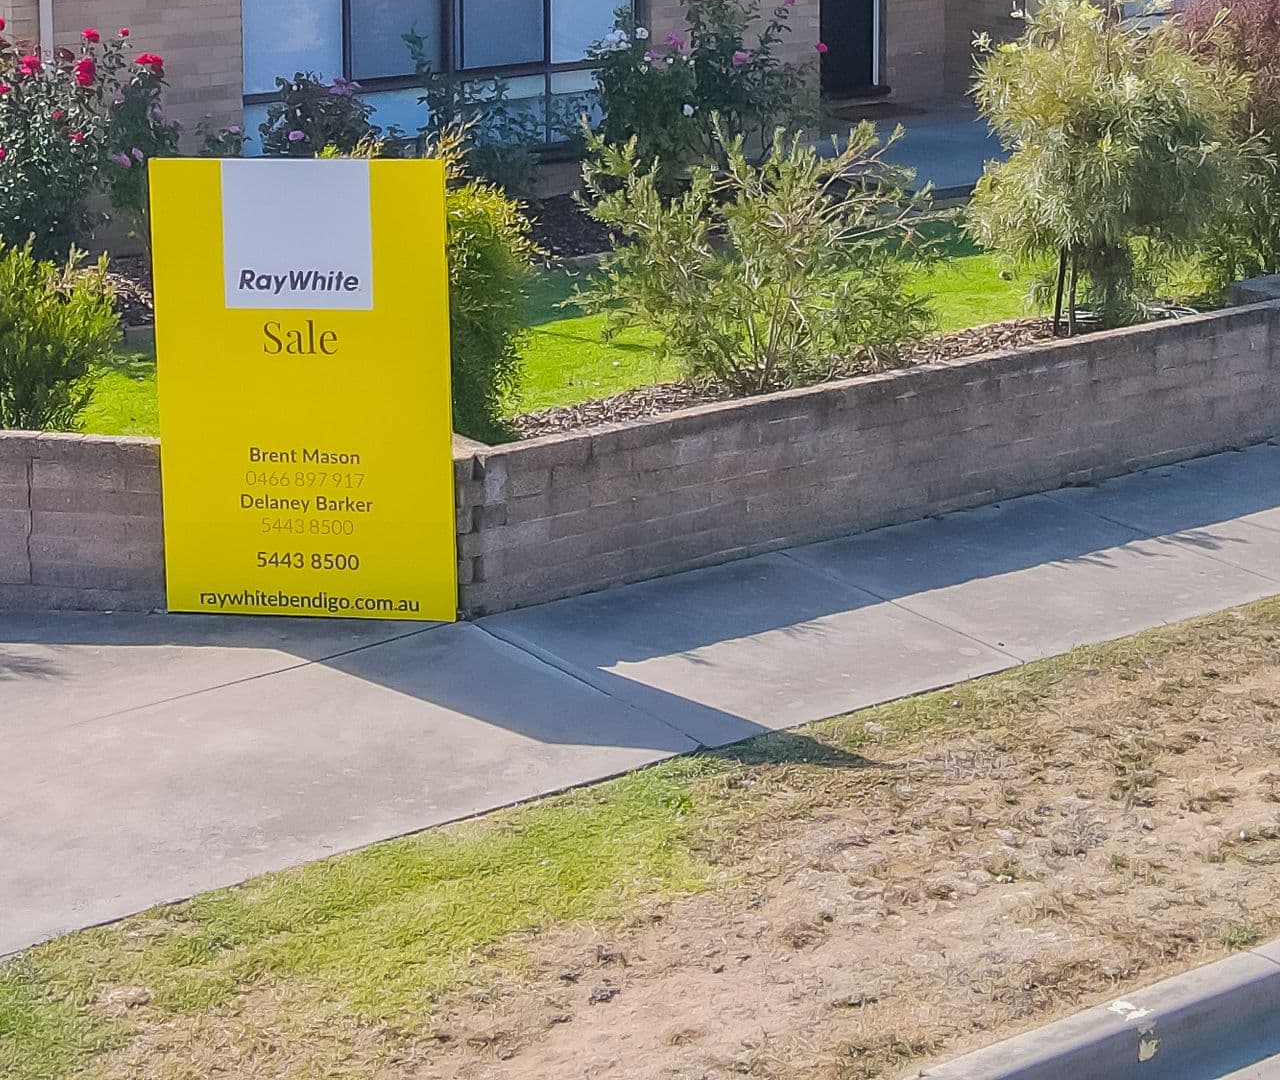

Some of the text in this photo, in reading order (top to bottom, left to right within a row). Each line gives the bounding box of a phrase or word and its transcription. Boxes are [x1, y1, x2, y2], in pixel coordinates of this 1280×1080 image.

[263, 319, 339, 355] Sale
[249, 447, 361, 465] Brent Mason
[245, 470, 365, 489] 0466 897 917
[240, 493, 373, 513] Delaney Barker
[261, 517, 354, 536] 5443 8500
[256, 551, 360, 571] 5443 8500
[200, 590, 419, 613] raywhitebendigo.com.au
